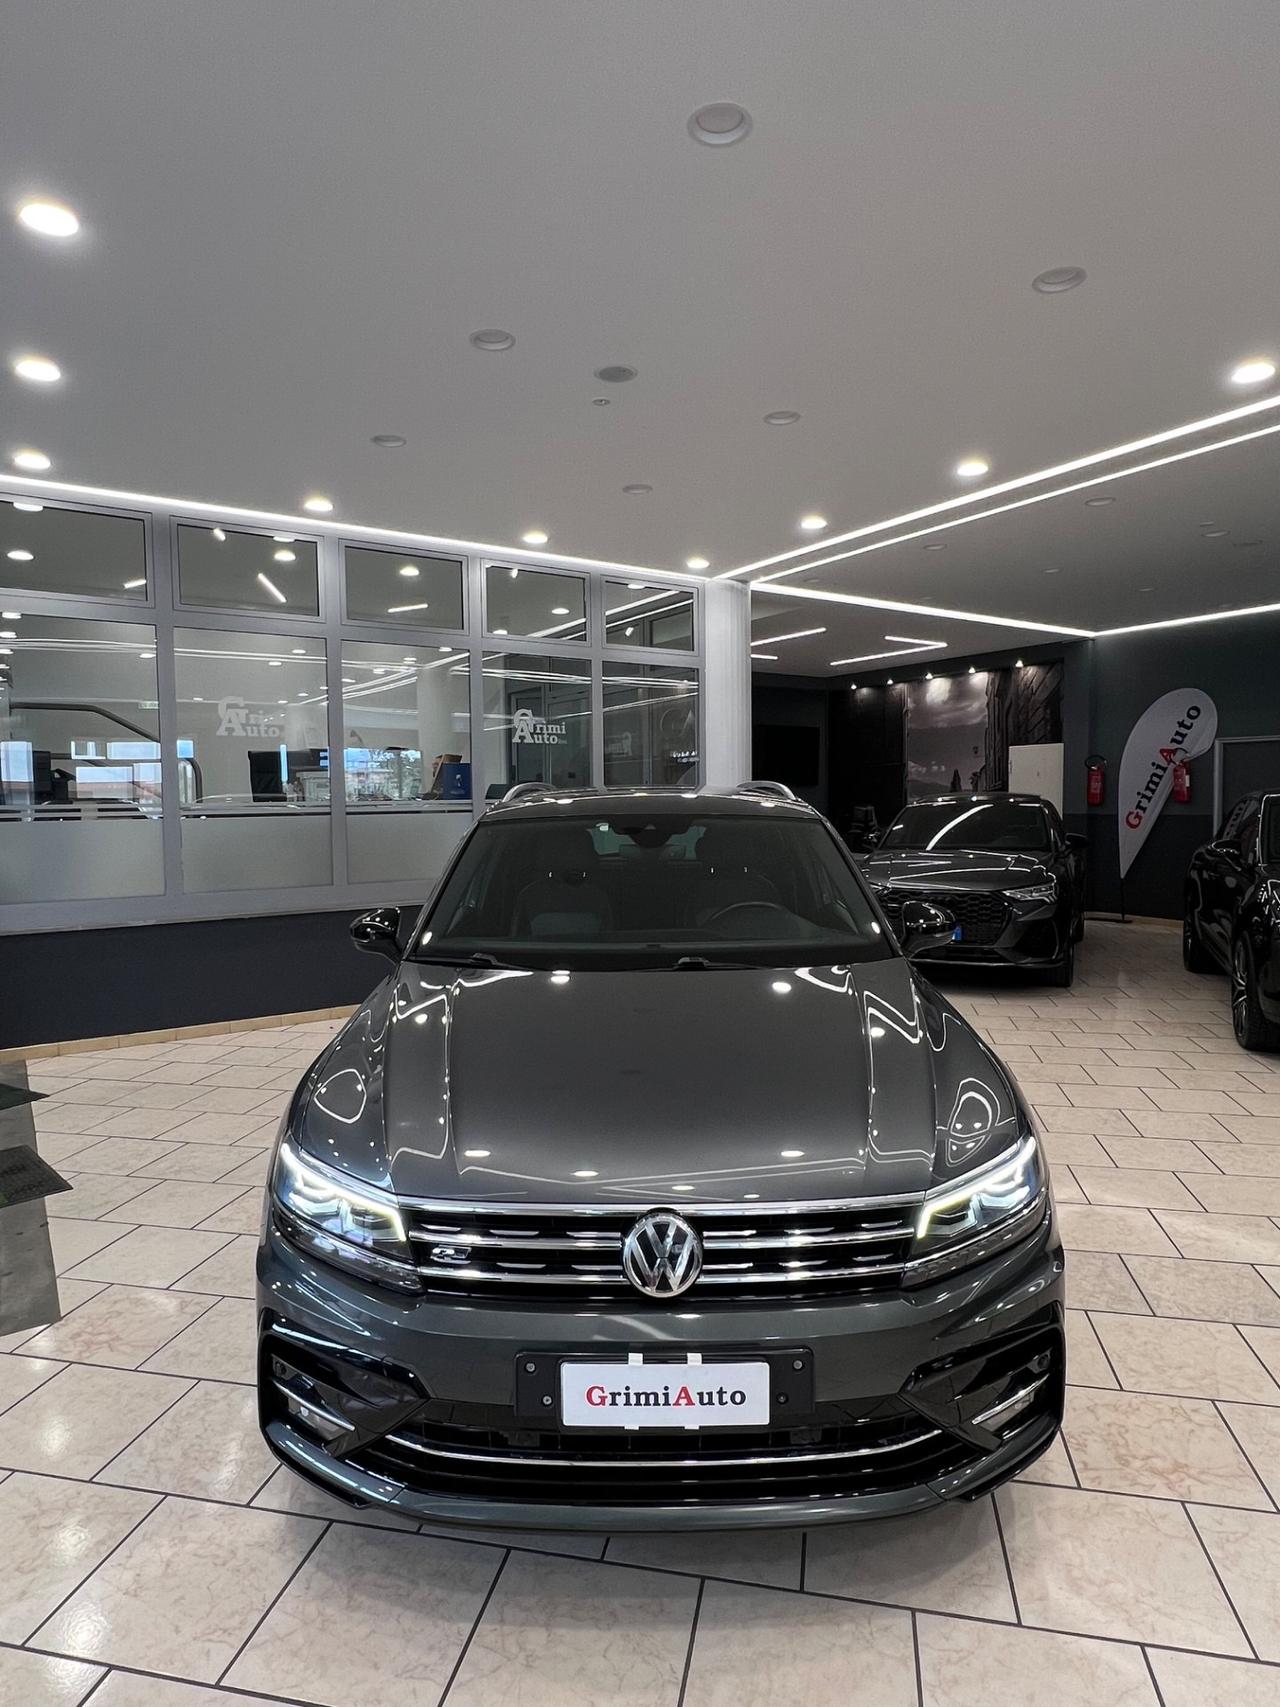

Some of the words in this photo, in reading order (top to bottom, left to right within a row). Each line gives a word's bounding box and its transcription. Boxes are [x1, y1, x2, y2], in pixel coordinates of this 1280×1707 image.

[216, 709, 280, 737] Auto
[512, 720, 558, 744] Auto
[513, 709, 567, 734] Grimi
[1126, 705, 1201, 829] GrimiAuto
[586, 1385, 747, 1407] GrimiAuto
